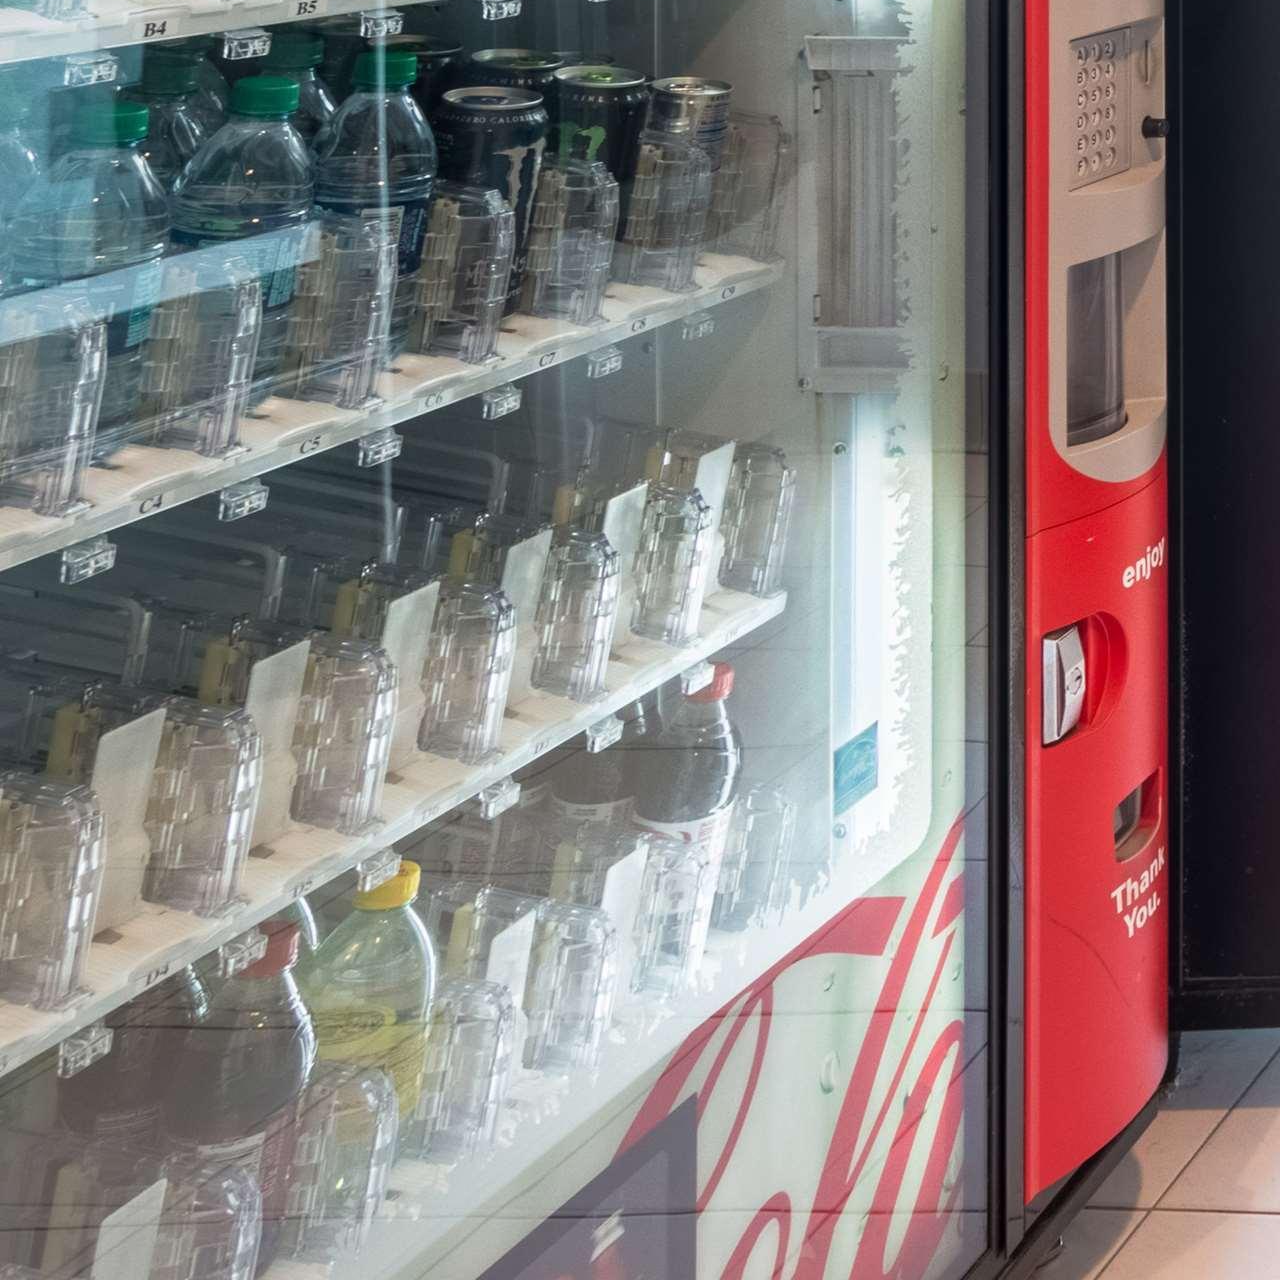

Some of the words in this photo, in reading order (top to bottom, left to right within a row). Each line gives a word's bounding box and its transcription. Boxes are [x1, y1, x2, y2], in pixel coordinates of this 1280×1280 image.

[295, 0, 318, 16] B5
[143, 20, 168, 38] B4
[720, 285, 736, 300] C9
[539, 351, 556, 368] C7
[425, 392, 444, 408] C6
[299, 433, 322, 455] C5
[139, 494, 163, 514] C4
[1122, 536, 1165, 588] enjoy
[1110, 846, 1165, 914] Thank
[1123, 891, 1161, 939] You.
